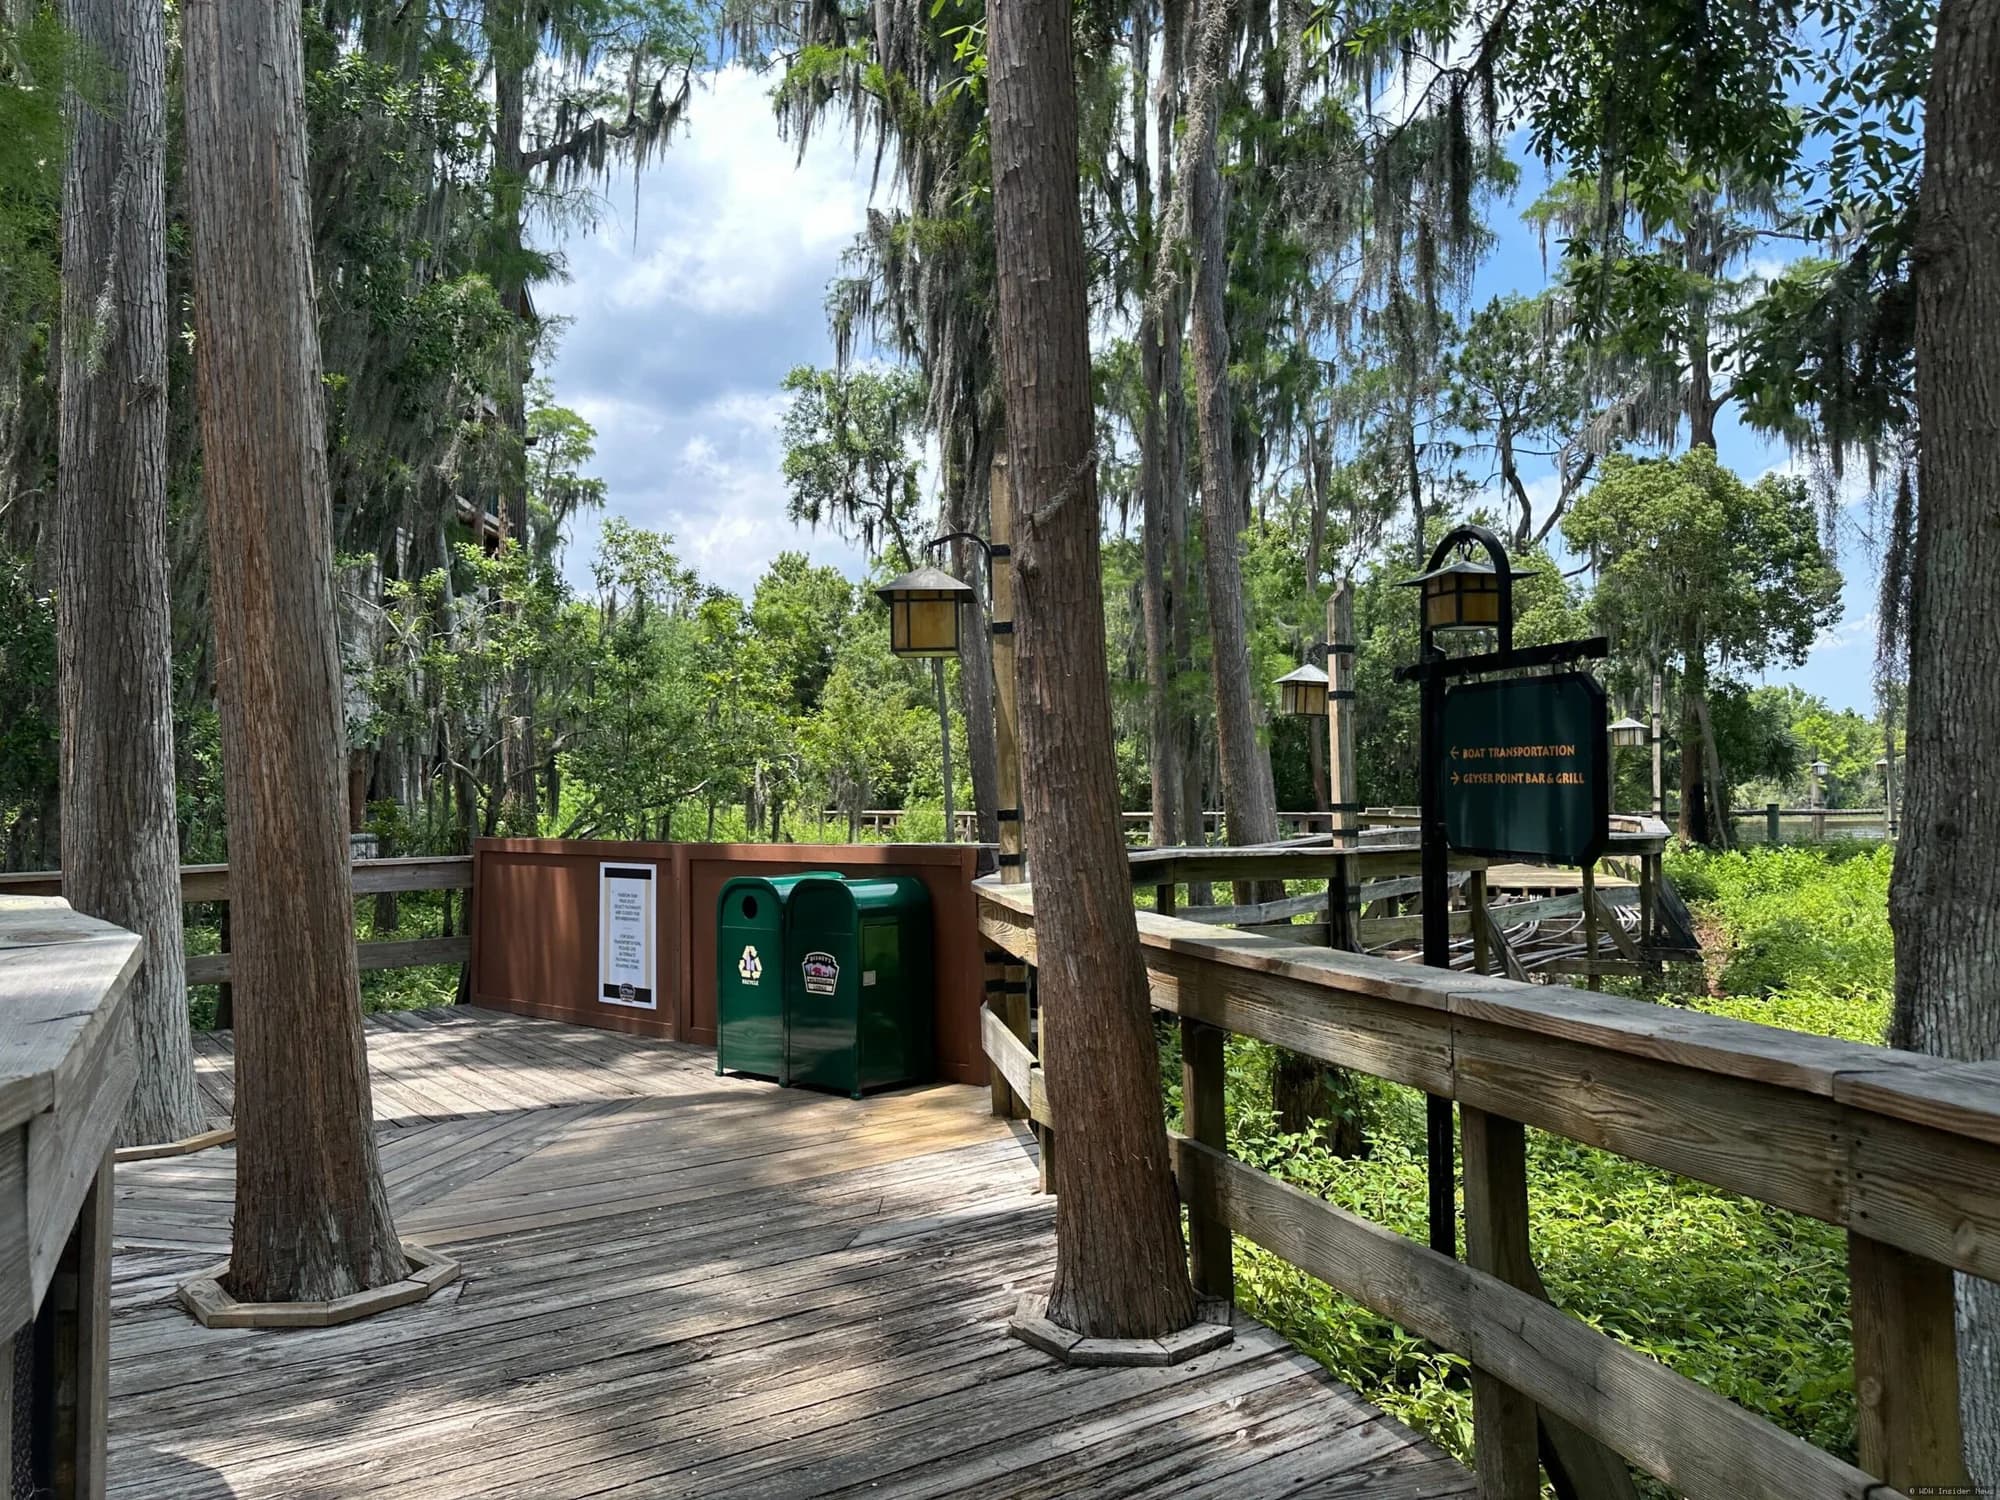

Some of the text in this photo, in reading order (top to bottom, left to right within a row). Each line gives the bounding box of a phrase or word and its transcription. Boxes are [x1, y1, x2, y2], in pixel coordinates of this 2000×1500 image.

[1463, 745, 1575, 759] BOAT TRANSPORTATION
[1463, 773, 1585, 784] GEYSER POINT BAR & GRILL
